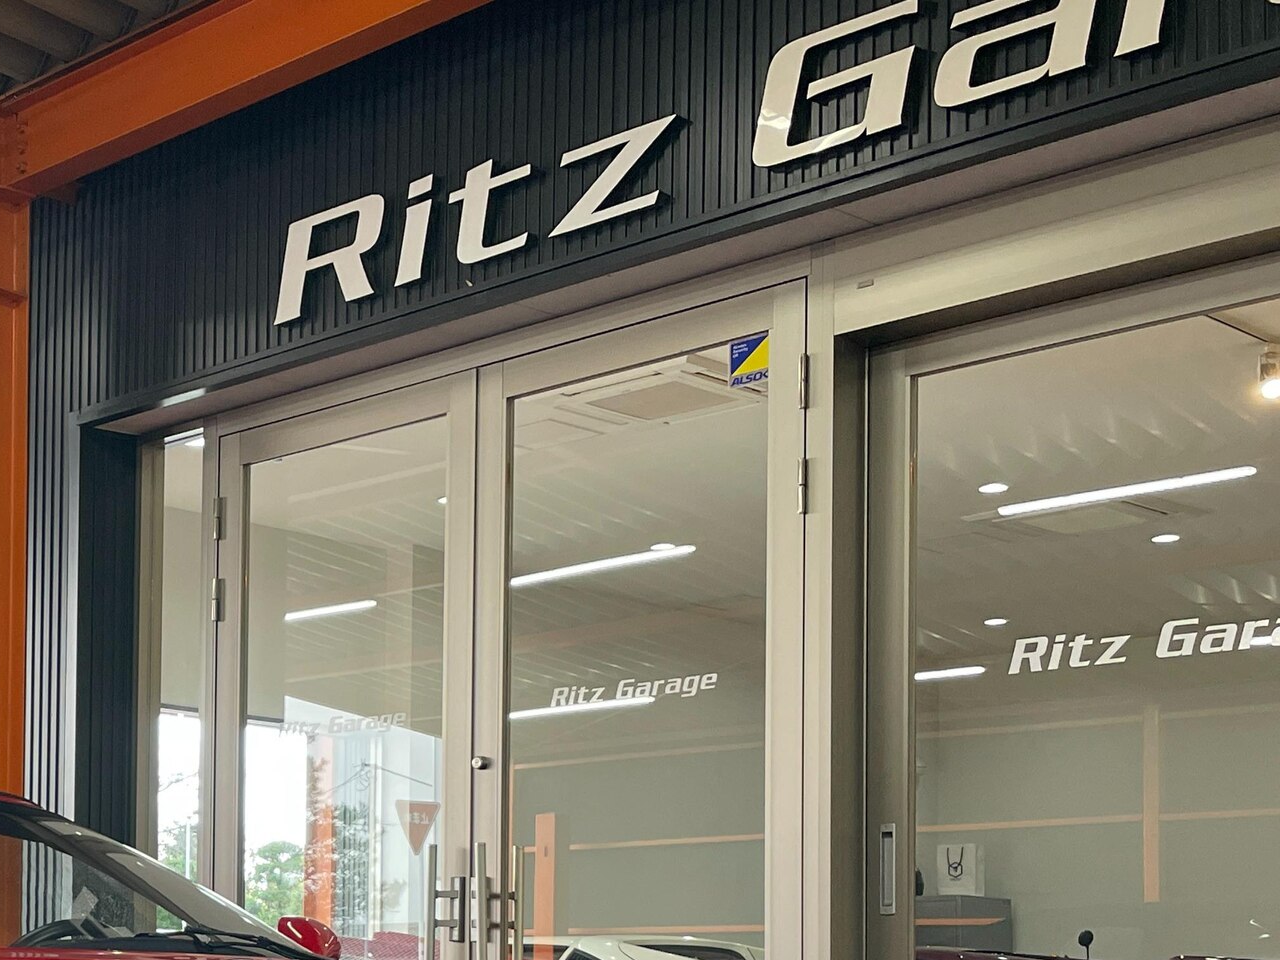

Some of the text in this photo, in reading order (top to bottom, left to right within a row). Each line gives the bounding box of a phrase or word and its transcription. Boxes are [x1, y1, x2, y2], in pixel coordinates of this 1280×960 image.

[274, 114, 677, 326] Ritz
[1008, 634, 1131, 676] Ritz
[550, 672, 718, 708] Ritz Garage
[328, 712, 407, 734] Garage
